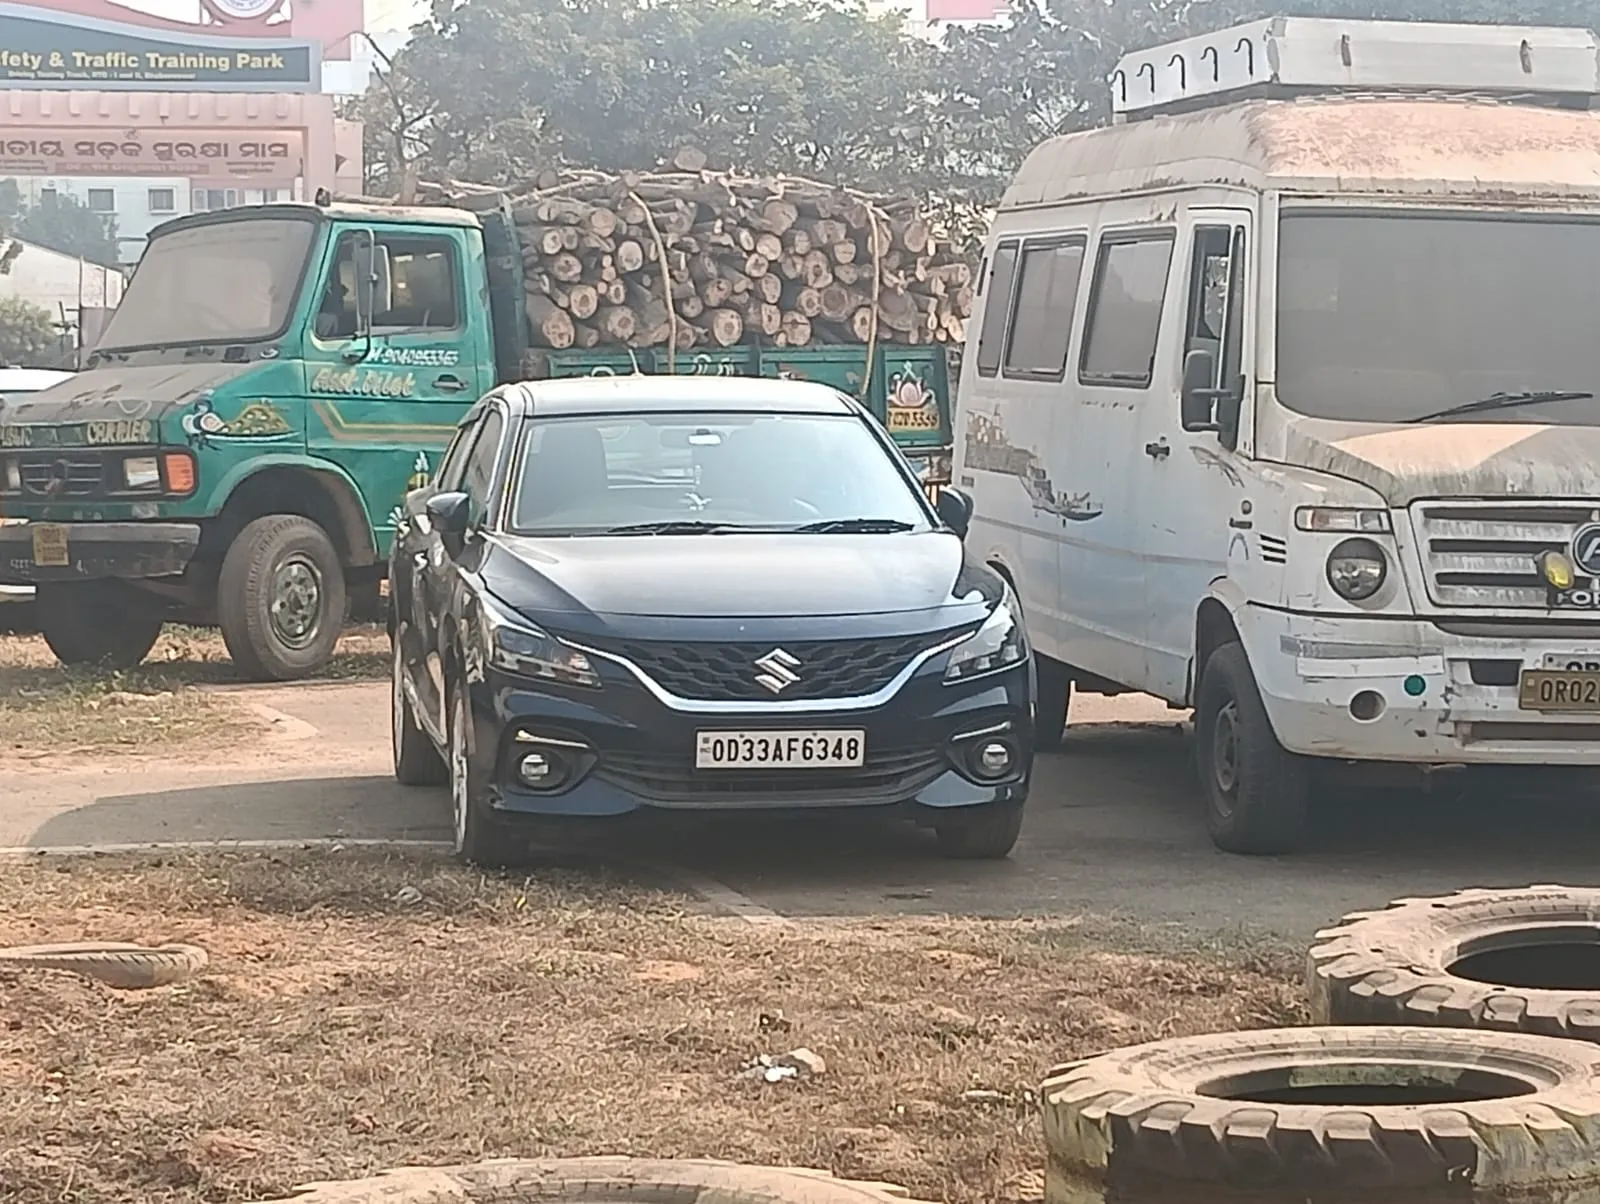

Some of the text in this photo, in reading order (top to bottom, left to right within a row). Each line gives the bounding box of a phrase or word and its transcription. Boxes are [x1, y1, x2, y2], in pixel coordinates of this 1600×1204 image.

[49, 51, 65, 68] &
[72, 51, 139, 68] Traffic
[145, 52, 230, 71] Training
[236, 52, 284, 68] Park
[239, 142, 288, 158] ମାସ
[87, 421, 151, 444] CARRIER
[1541, 680, 1600, 703] OR02
[712, 737, 860, 762] OD33AF6348
